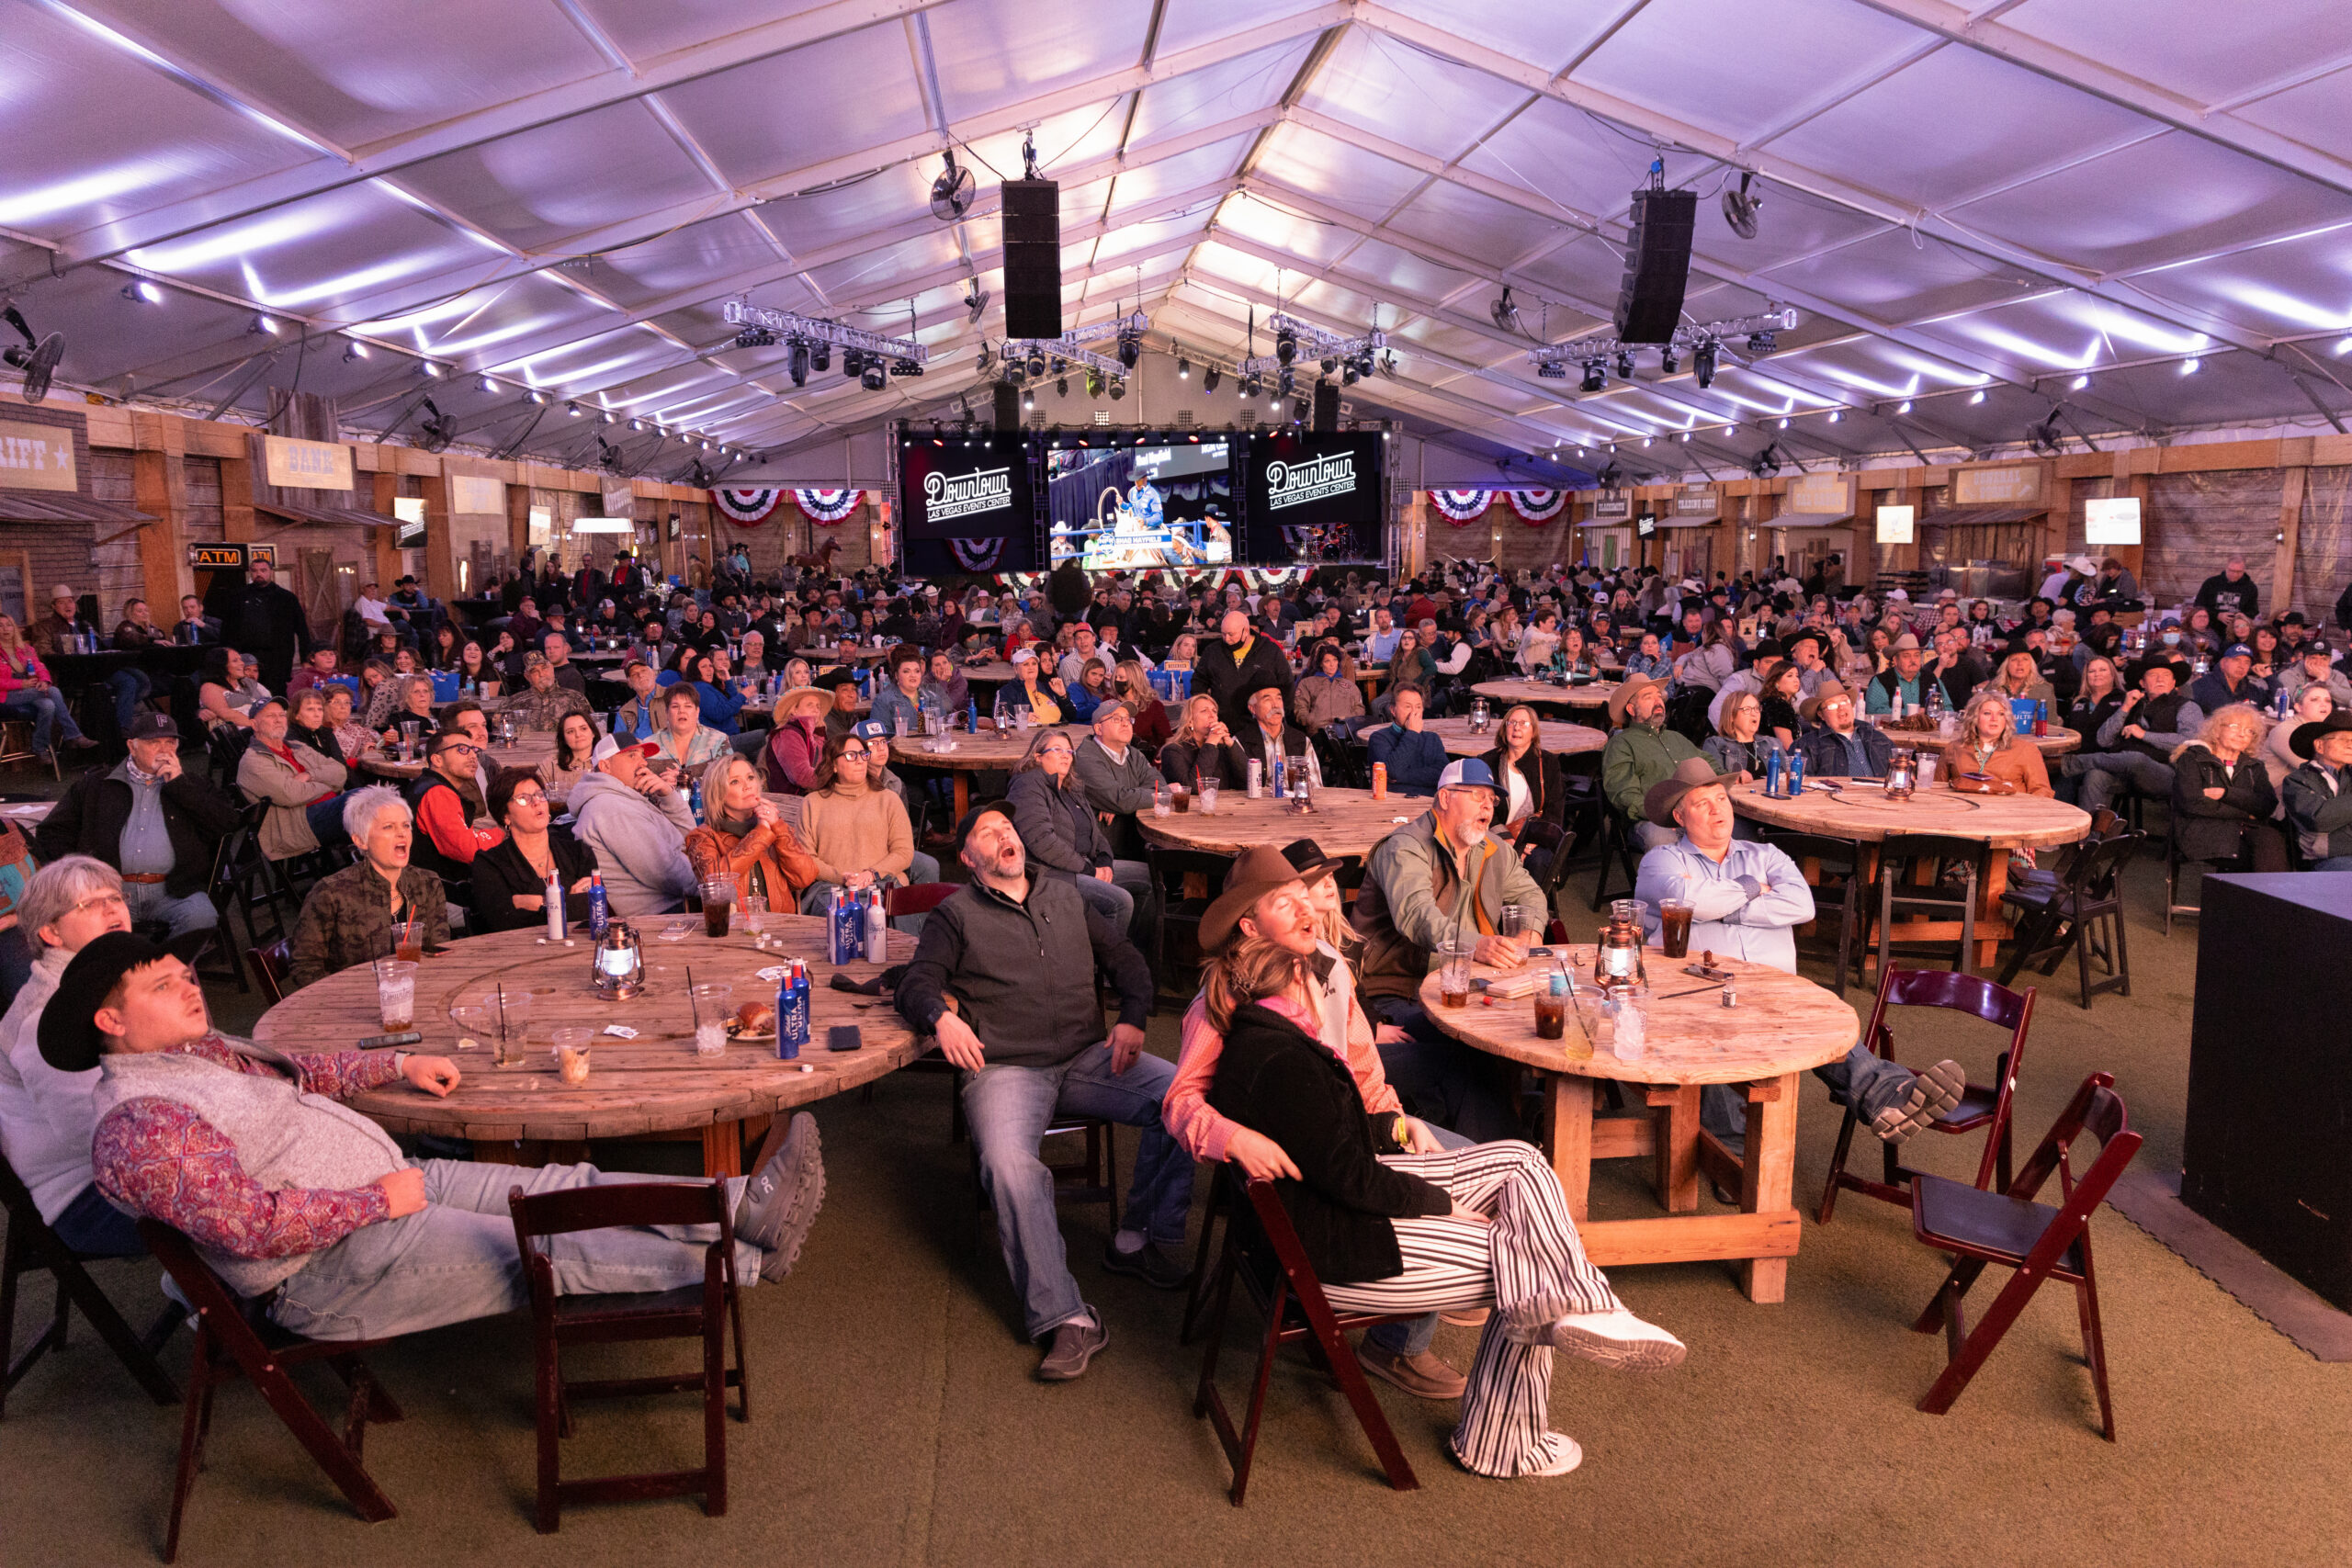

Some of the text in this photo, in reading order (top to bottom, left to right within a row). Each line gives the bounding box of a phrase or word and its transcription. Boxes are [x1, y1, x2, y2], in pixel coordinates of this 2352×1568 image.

[288, 446, 334, 474] BANK
[1266, 450, 1356, 494] Downtown
[924, 467, 1012, 506] Downtown
[1270, 480, 1355, 507] LAS VEGAS EVENTS CENTER
[927, 496, 1011, 519] LAS VEGAS EVENTS CENTER
[198, 551, 237, 563] ATM
[596, 899, 605, 927] ULTRA
